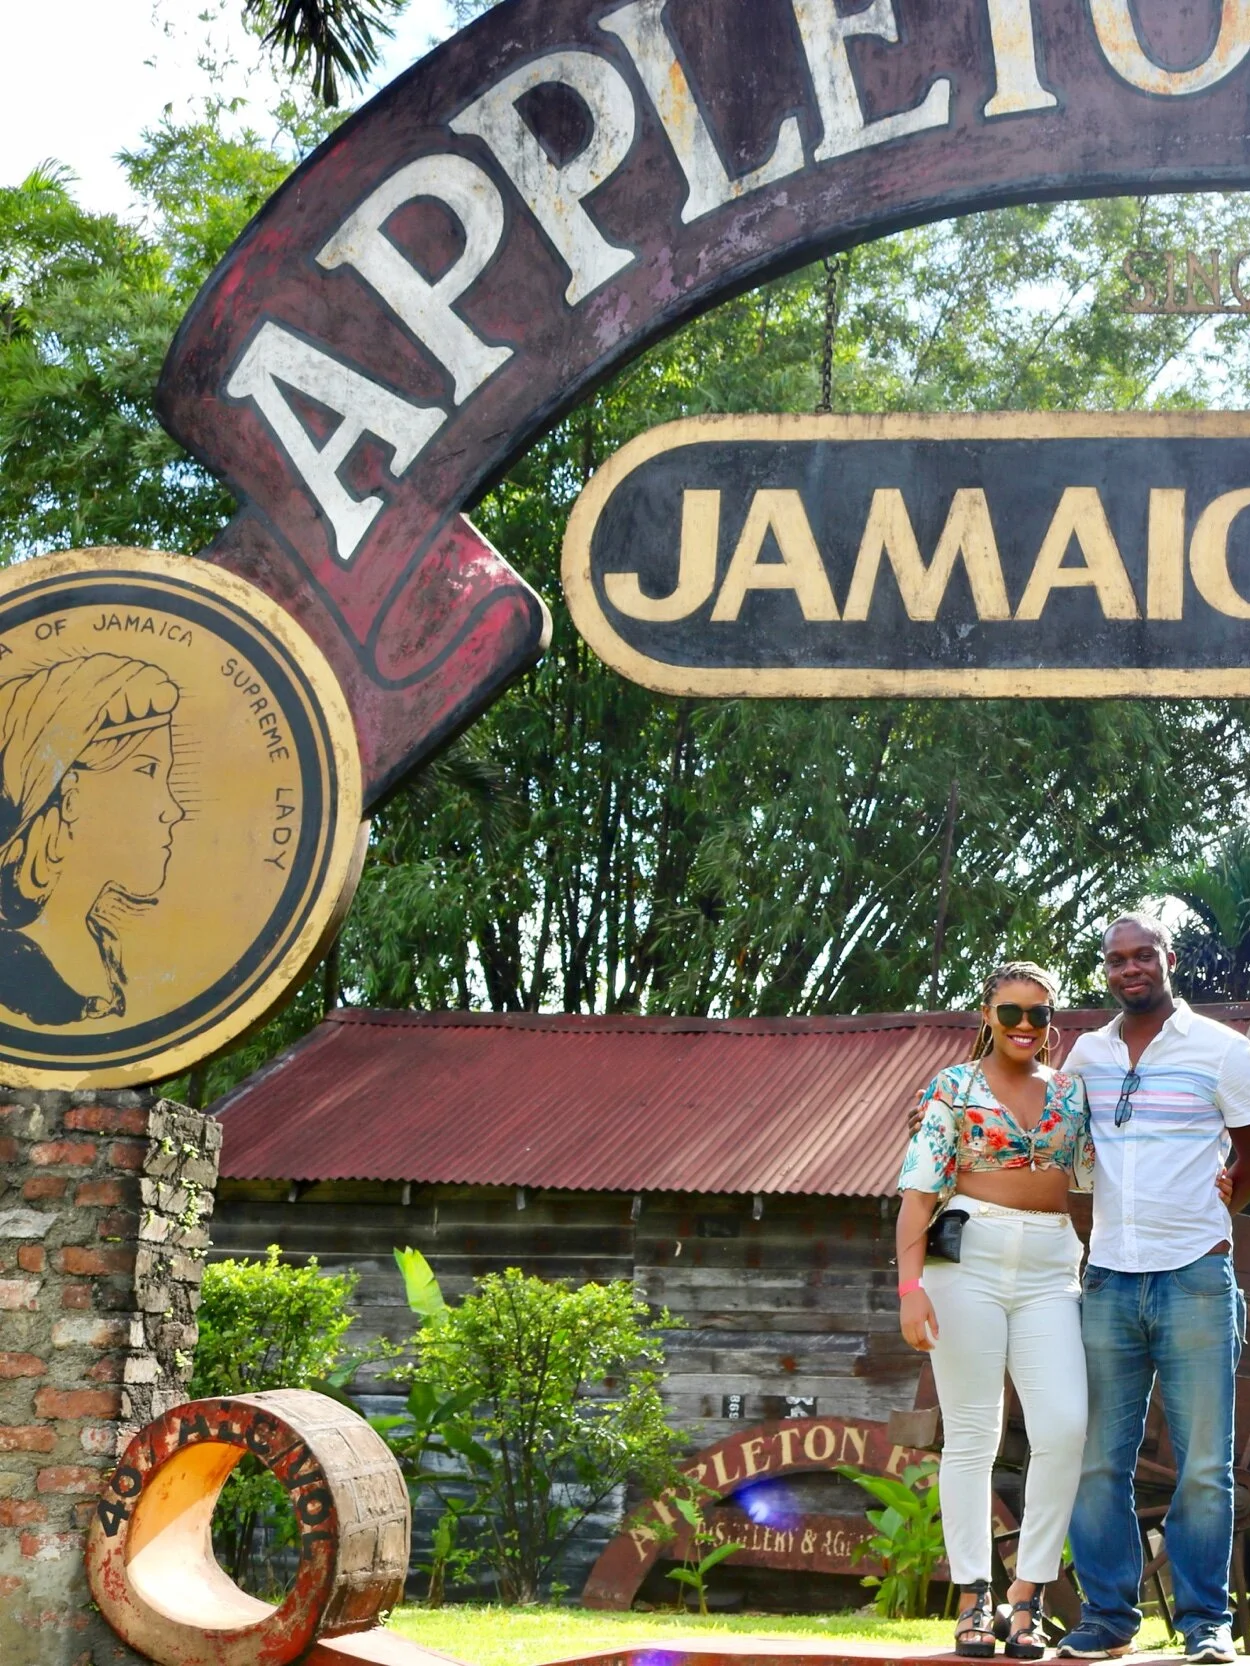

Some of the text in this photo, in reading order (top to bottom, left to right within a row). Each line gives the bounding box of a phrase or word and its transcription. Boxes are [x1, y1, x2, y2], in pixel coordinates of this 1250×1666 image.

[35, 613, 296, 871] OF JAMAICA SUPREME LADY
[801, 1528, 818, 1554] &
